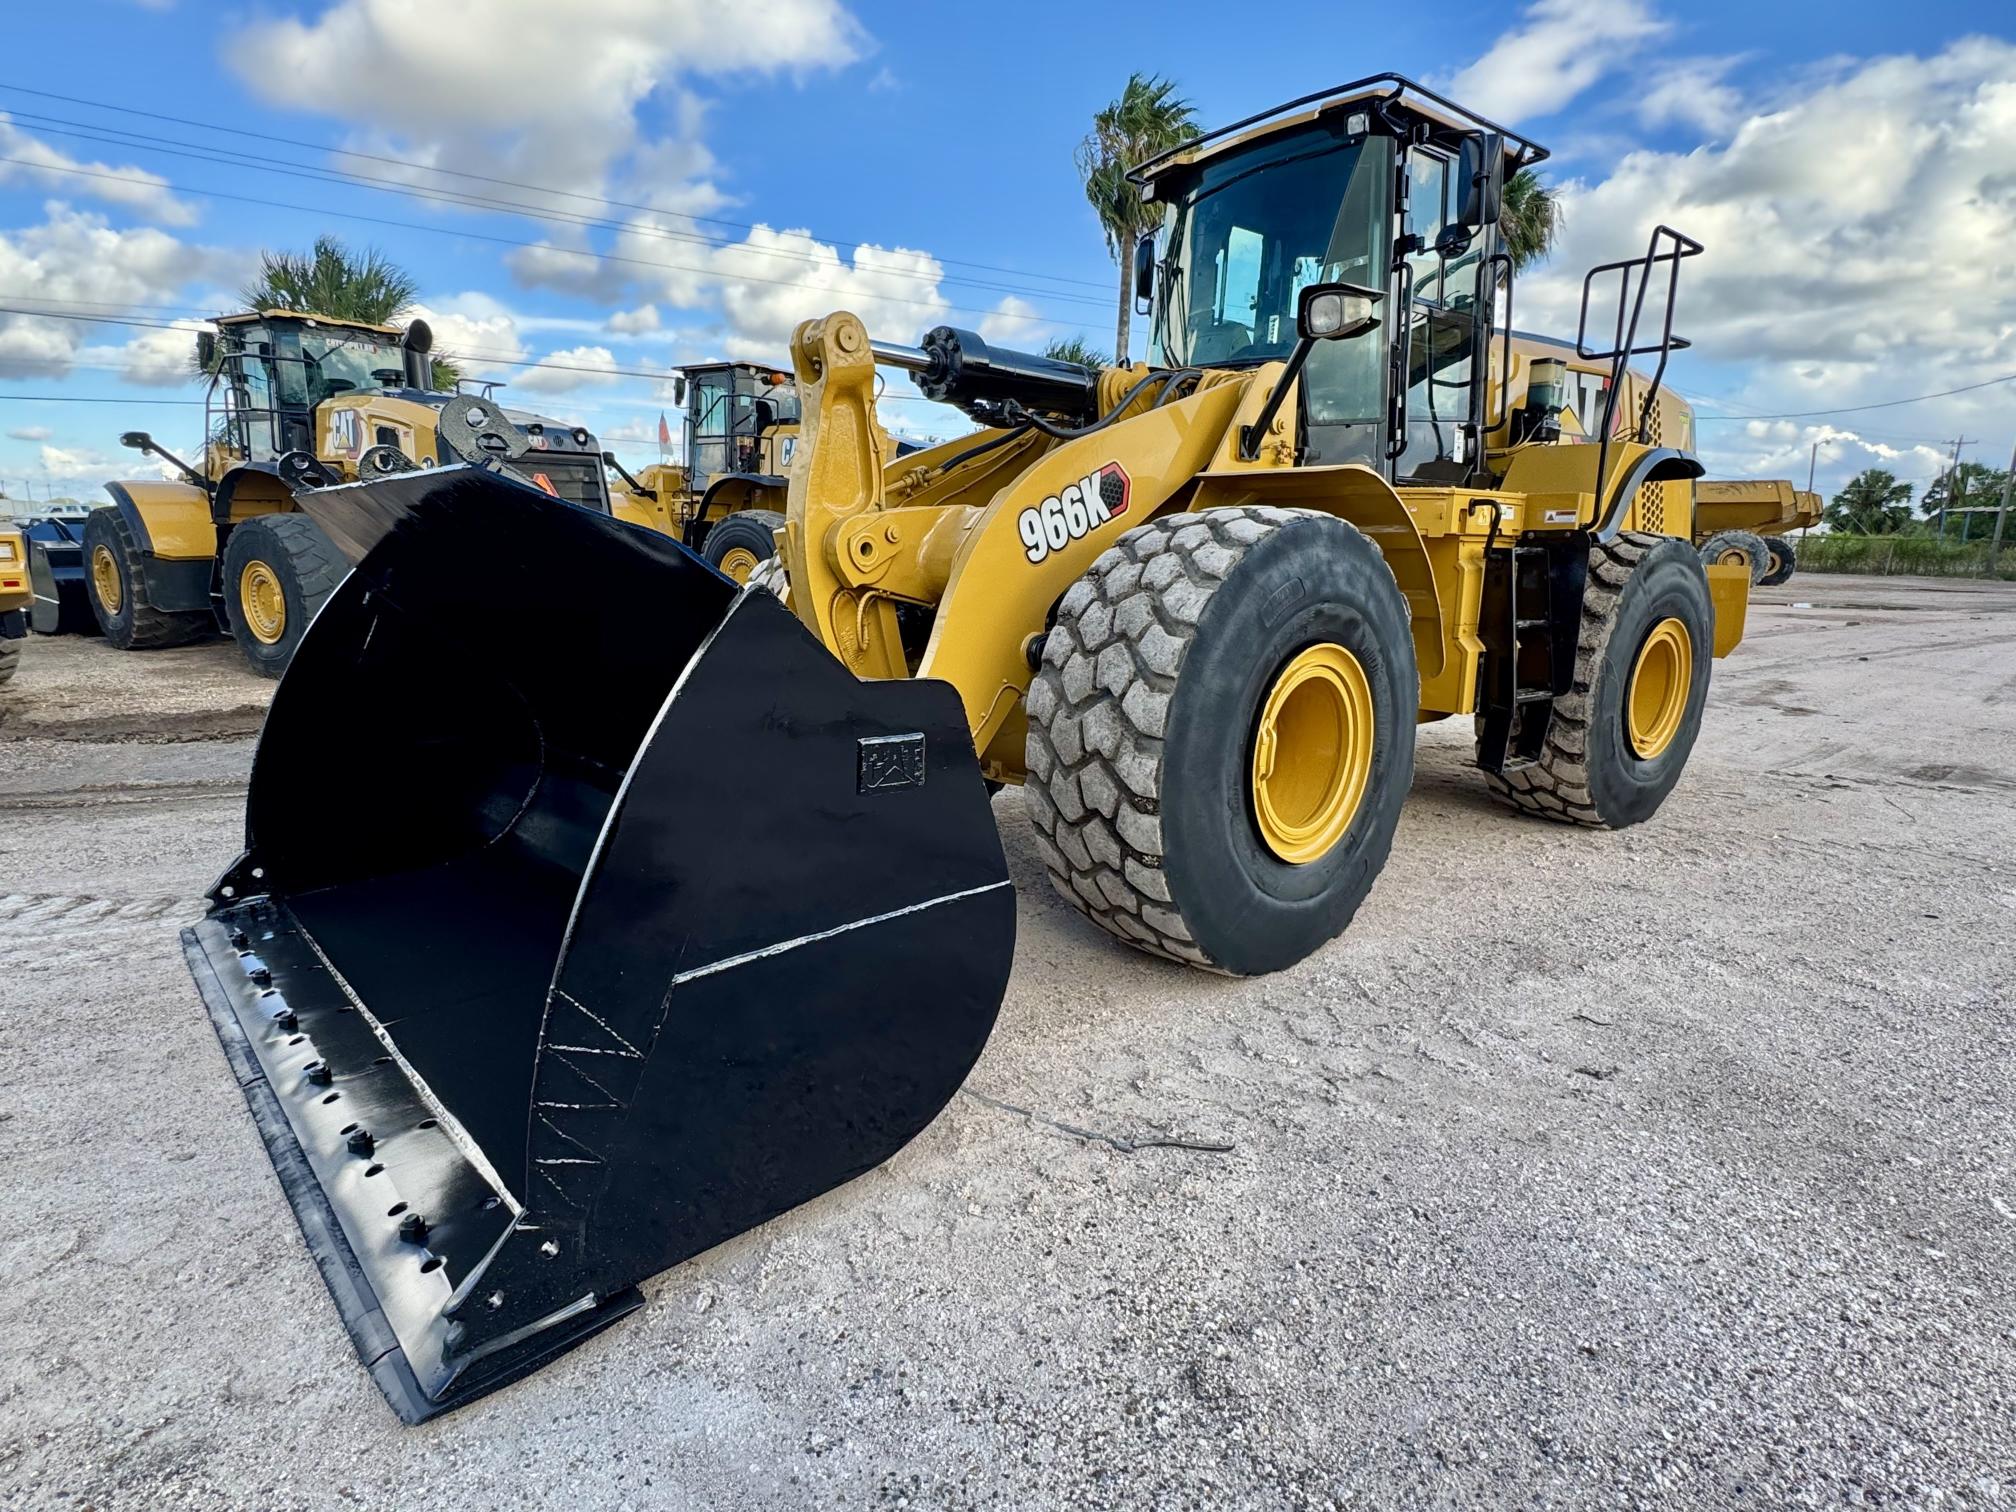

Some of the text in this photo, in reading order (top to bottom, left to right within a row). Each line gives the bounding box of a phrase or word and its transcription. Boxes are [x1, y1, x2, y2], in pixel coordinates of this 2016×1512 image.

[334, 410, 354, 448] CAT
[1560, 370, 1604, 437] AT
[782, 438, 798, 466] CA
[1019, 471, 1112, 562] 966K
